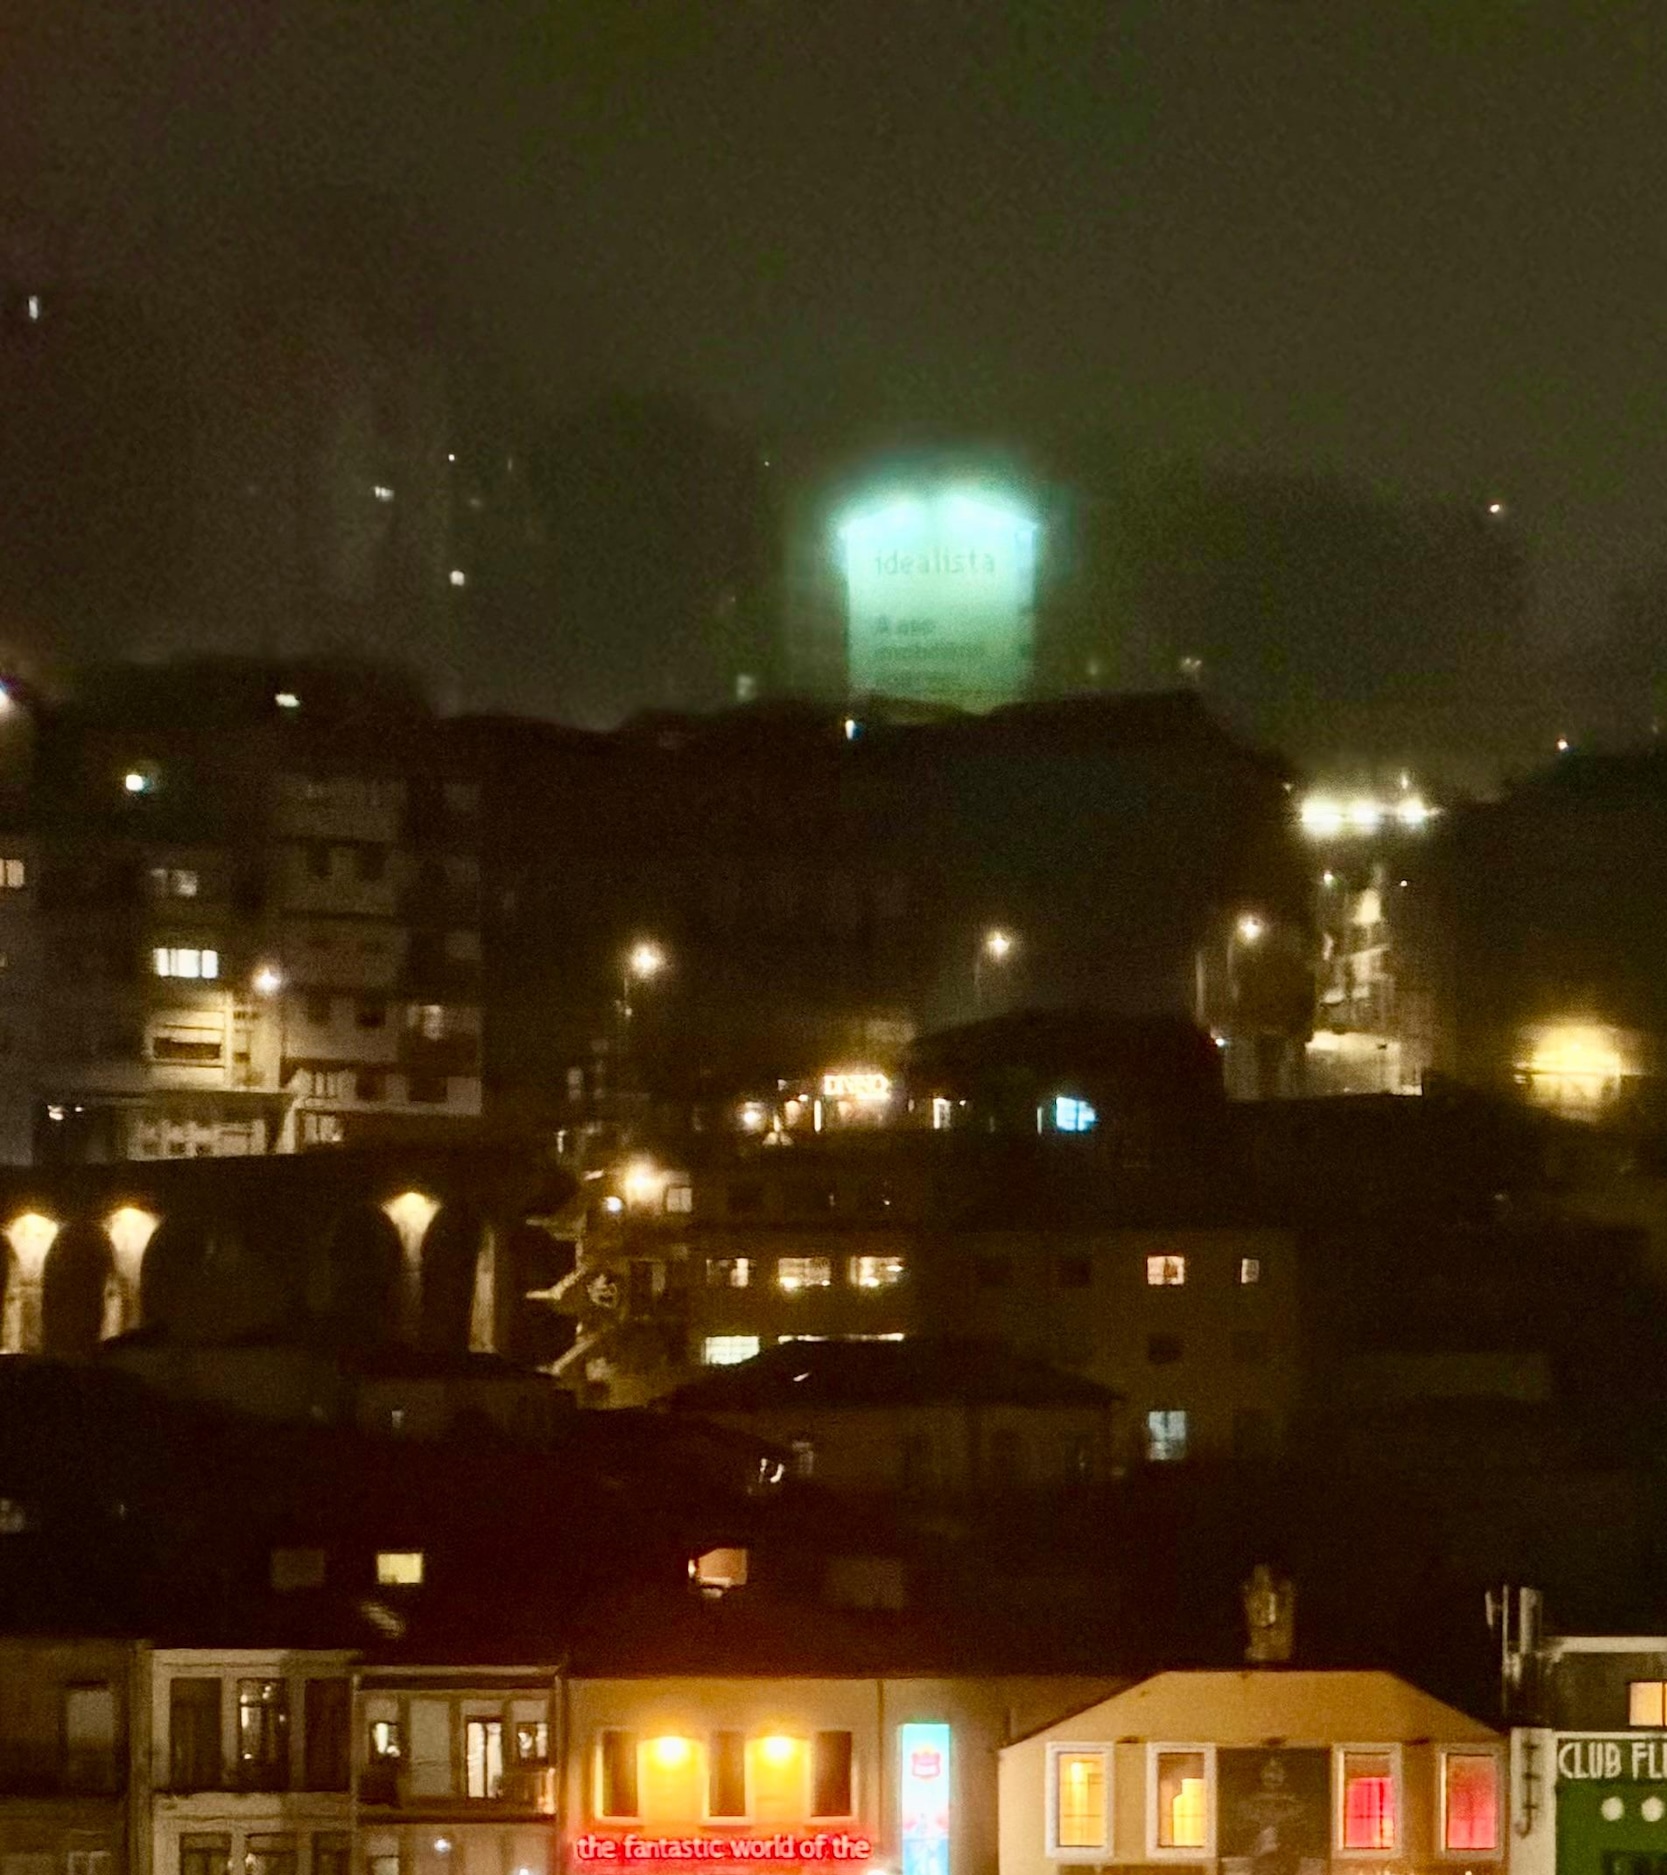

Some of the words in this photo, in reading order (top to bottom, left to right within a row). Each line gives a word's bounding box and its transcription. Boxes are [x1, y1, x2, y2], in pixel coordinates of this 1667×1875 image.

[876, 549, 996, 576] idealista
[1558, 1741, 1622, 1779] CLUB
[577, 1834, 617, 1860] the
[624, 1833, 724, 1860] fantastic
[730, 1834, 796, 1860] world
[799, 1833, 828, 1860] of
[832, 1834, 871, 1860] the
